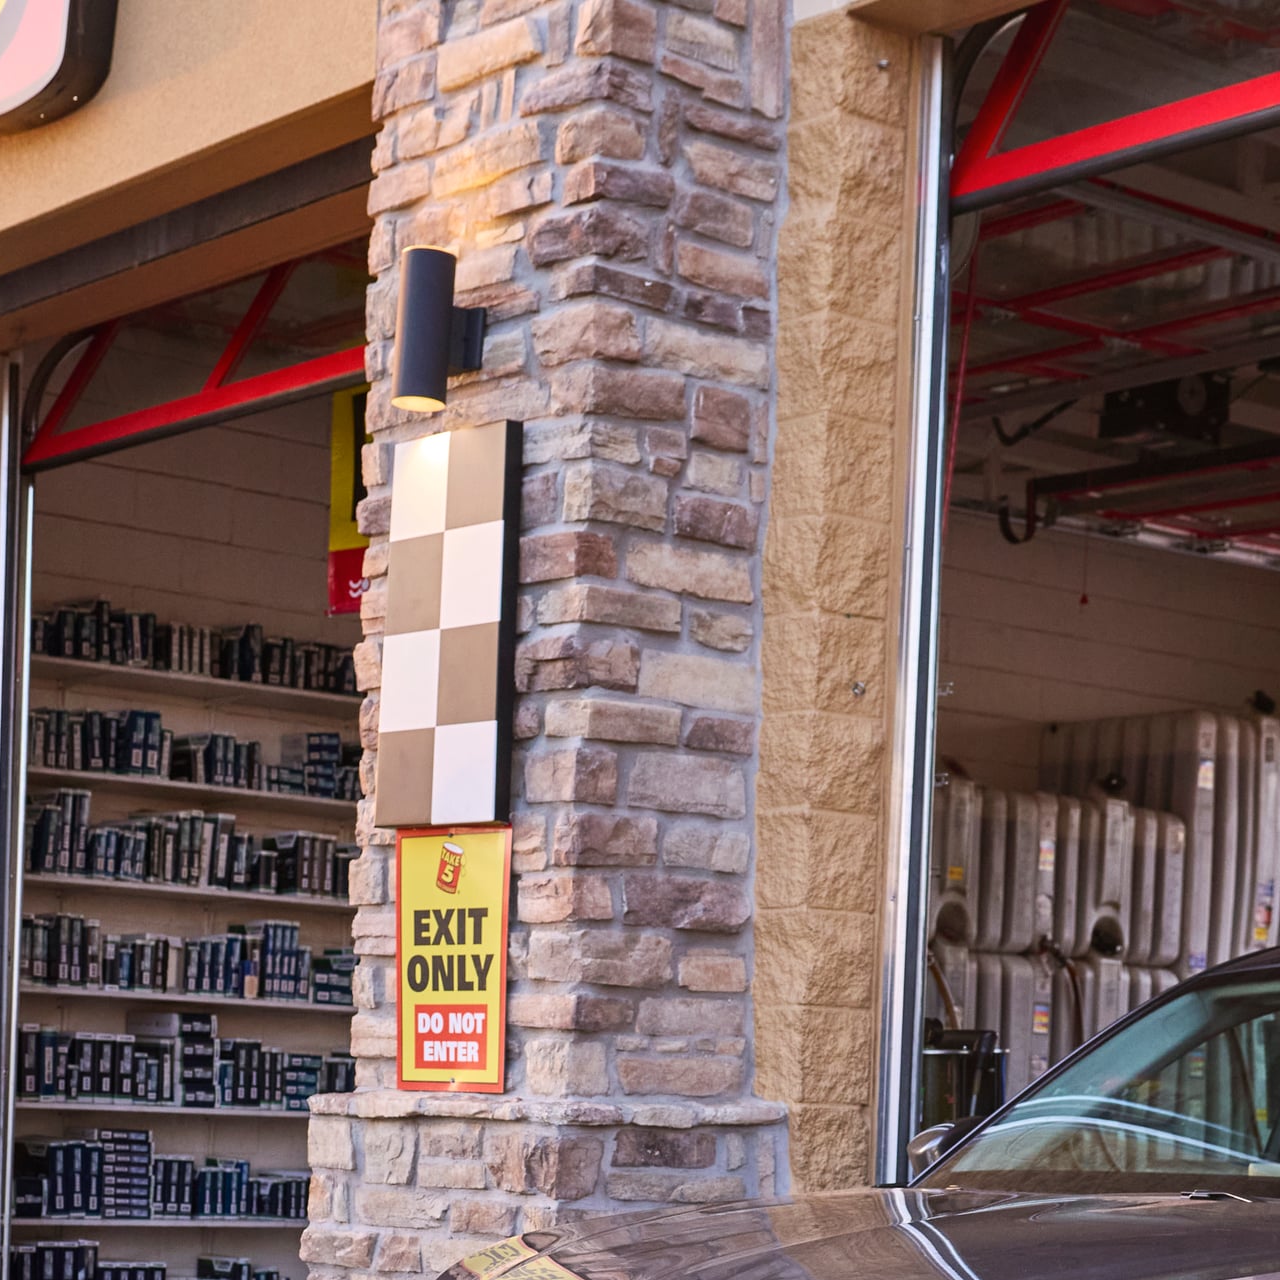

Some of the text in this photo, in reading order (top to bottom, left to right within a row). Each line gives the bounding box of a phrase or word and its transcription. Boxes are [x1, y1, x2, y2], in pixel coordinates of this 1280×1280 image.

[441, 849, 462, 867] TAKE
[441, 864, 455, 883] 5
[413, 908, 488, 946] EXIT
[407, 954, 494, 992] ONLY
[418, 1012, 485, 1034] DO NOT
[423, 1041, 479, 1063] ENTER
